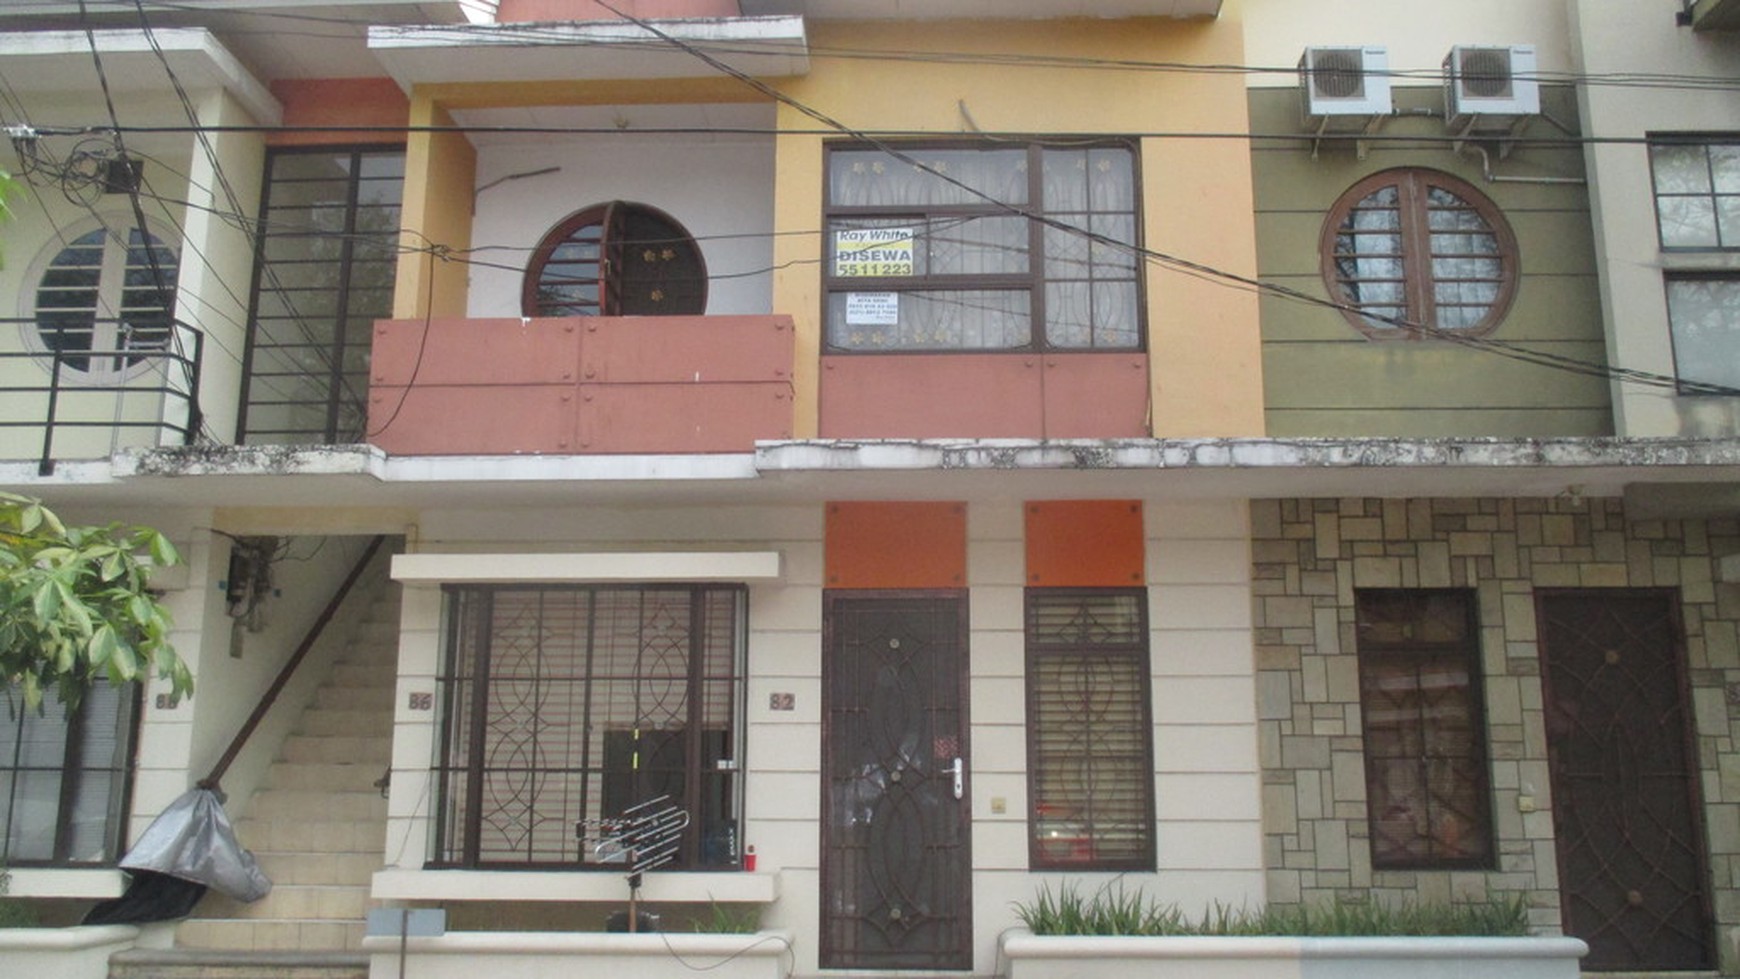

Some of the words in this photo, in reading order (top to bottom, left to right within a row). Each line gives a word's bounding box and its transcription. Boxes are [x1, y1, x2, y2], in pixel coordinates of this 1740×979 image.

[840, 231, 867, 241] Ray
[869, 230, 909, 240] White
[840, 250, 910, 261] DISEWA
[409, 693, 432, 710] 86
[770, 693, 794, 710] 82
